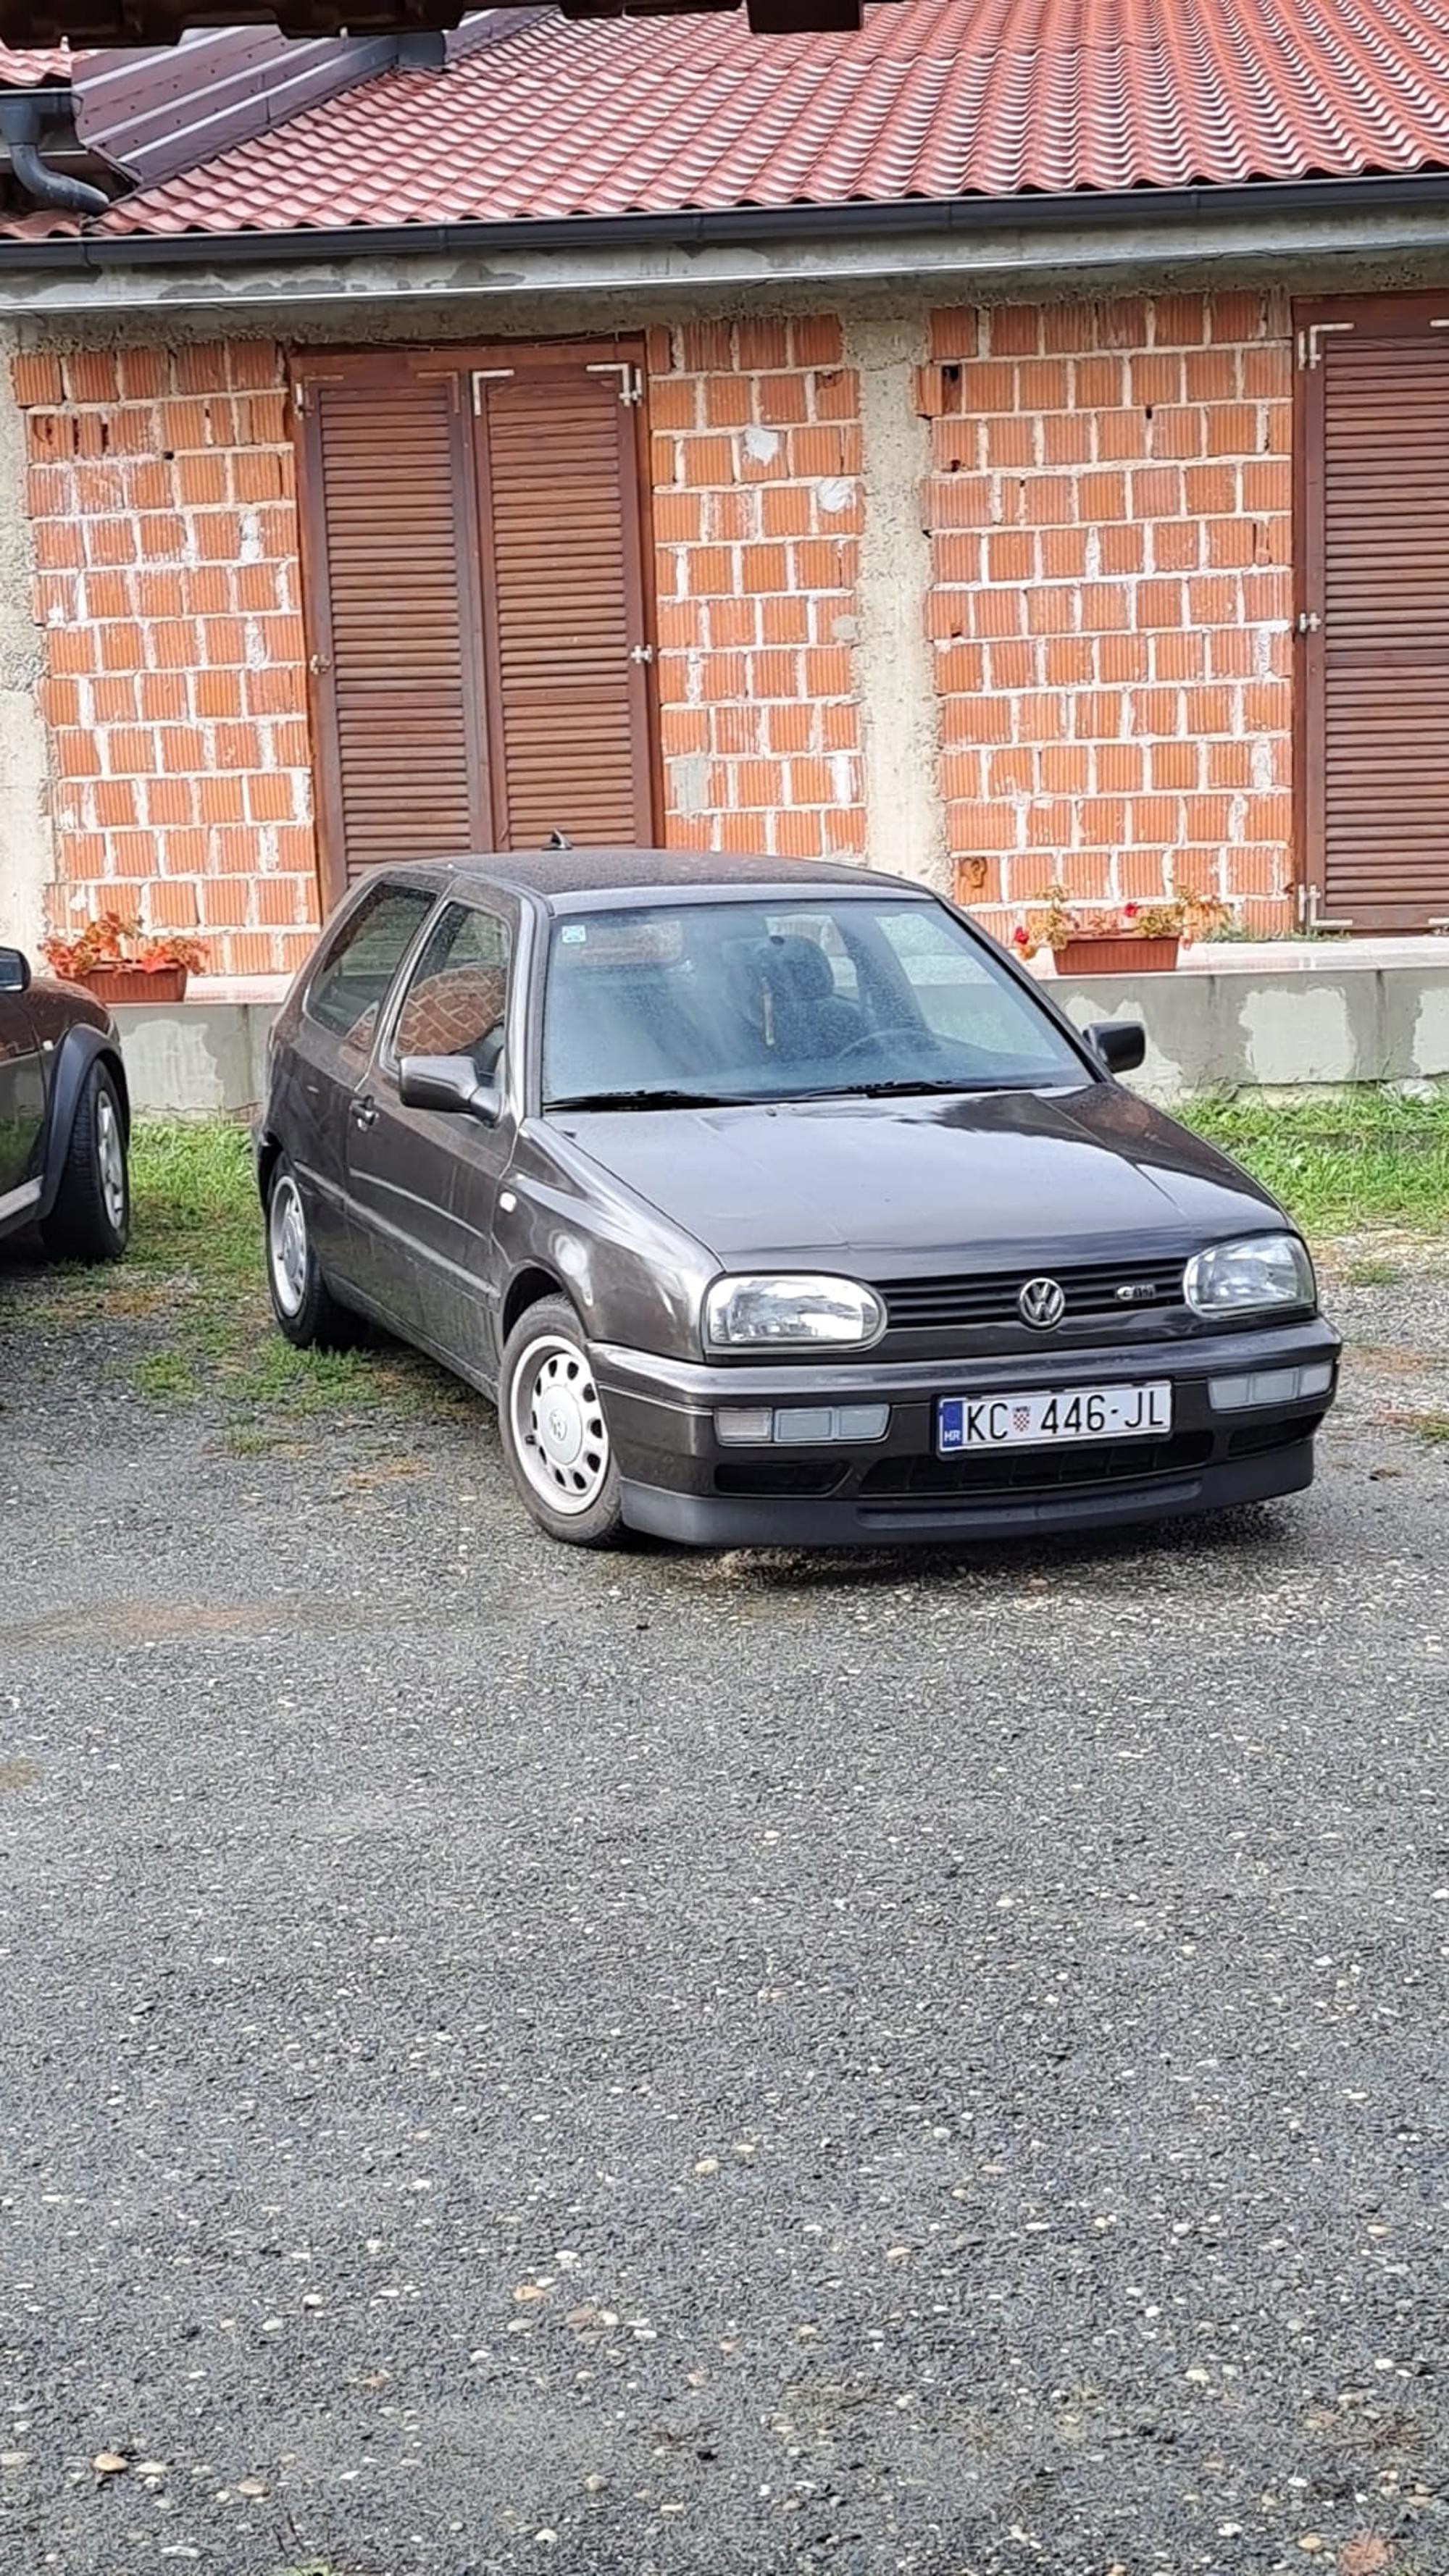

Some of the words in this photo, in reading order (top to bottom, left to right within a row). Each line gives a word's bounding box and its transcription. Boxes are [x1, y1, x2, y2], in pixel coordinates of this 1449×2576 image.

[967, 1403, 1008, 1442] KC
[1040, 1391, 1164, 1434] 446-JL
[944, 1429, 961, 1442] HR
